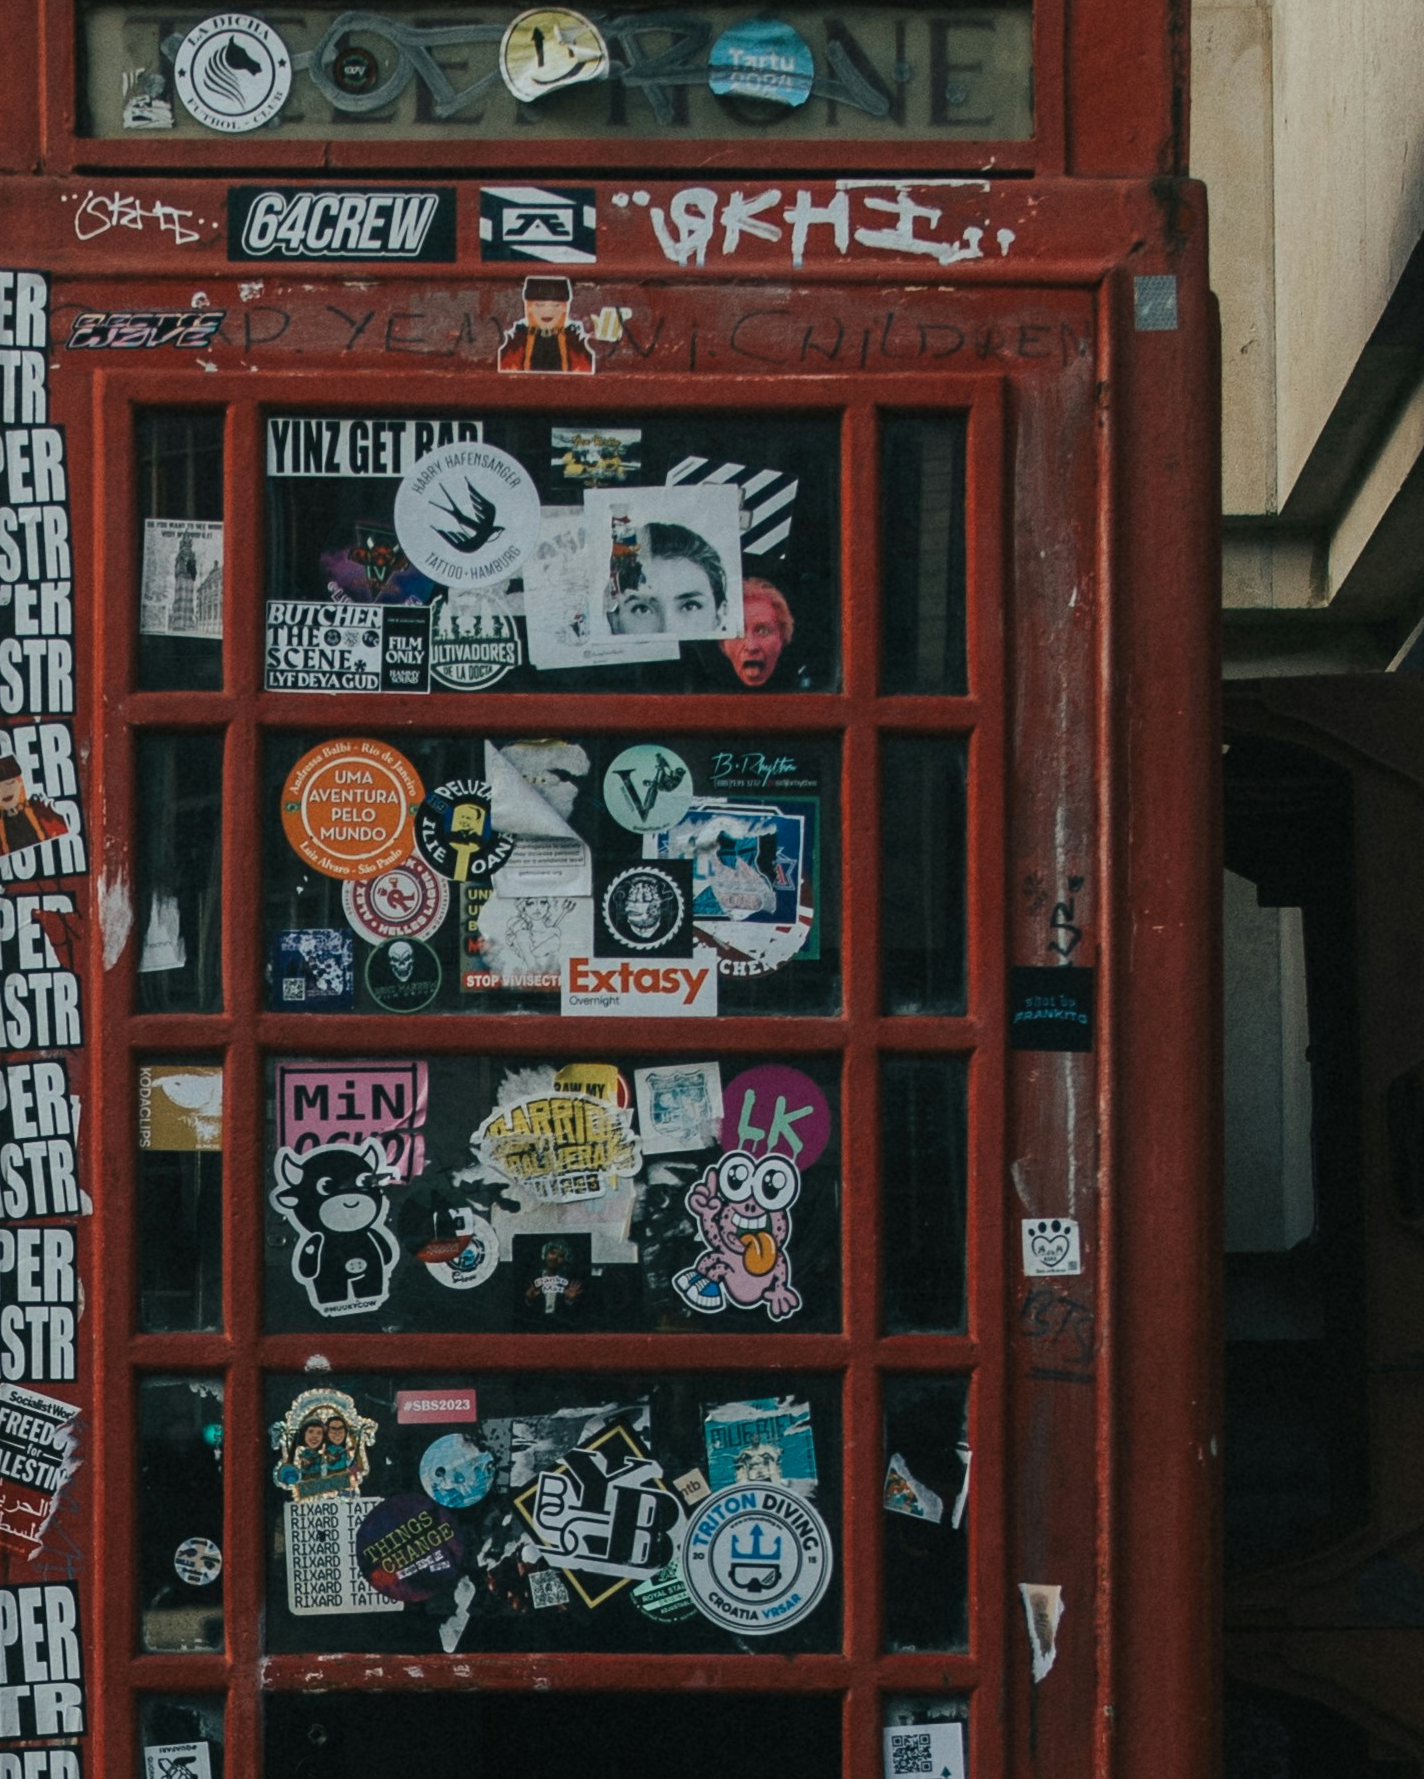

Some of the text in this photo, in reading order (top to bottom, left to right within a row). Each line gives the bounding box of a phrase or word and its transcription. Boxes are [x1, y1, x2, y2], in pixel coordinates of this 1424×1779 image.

[728, 47, 795, 72] Tartu
[245, 194, 436, 255] 64CREW
[270, 420, 341, 473] YINZ
[349, 421, 406, 474] GET
[268, 604, 381, 627] BUTCHER
[267, 627, 320, 647] THE
[389, 636, 422, 650] FILM
[385, 651, 425, 664] ONLY
[269, 673, 379, 689] LYF DEYA GUD
[334, 771, 373, 784] UMA
[309, 789, 398, 803] AVENTURA
[331, 808, 376, 822] PELO
[320, 827, 386, 841] MUNDO
[569, 957, 709, 1004] Extasy
[569, 996, 620, 1007] Overnight
[138, 1066, 152, 1148] KODACLIPS
[404, 1399, 470, 1411] #SBS2023
[27, 1443, 42, 1457] for
[291, 1505, 338, 1516] RIXARD
[291, 1517, 339, 1529] RIXARD
[693, 1493, 819, 1552] TRITON DIVING
[363, 1510, 433, 1564] THINGS
[292, 1543, 340, 1555] RIXARD
[381, 1522, 454, 1574] CHANGE
[293, 1556, 340, 1568] RIXARD
[293, 1569, 341, 1581] RIXARD
[294, 1582, 342, 1594] RIXARD
[708, 1592, 801, 1620] CROATIA VRSAR
